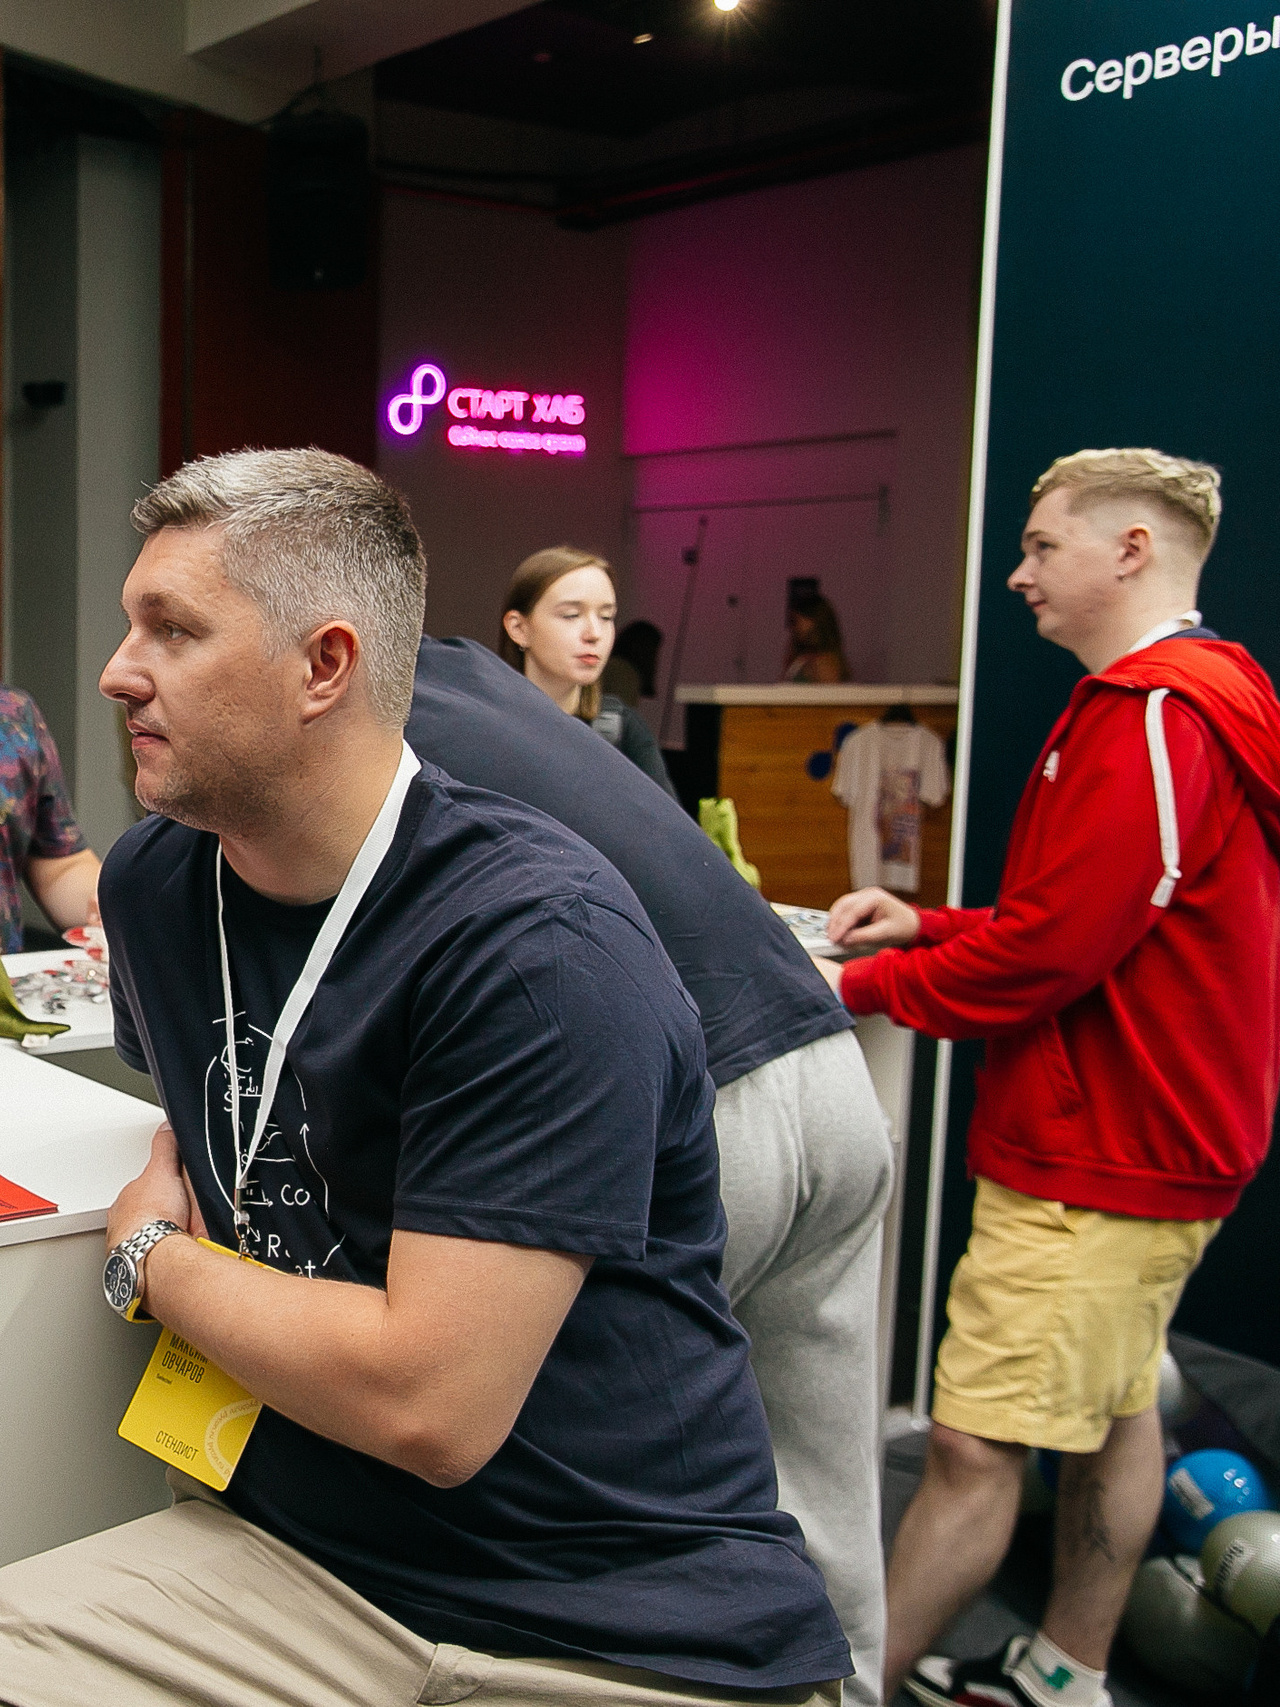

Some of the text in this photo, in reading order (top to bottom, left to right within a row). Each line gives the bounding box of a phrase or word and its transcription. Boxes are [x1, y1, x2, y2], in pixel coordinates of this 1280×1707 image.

[1060, 14, 1280, 101] Серверы
[447, 387, 585, 425] СТАРТ ХАБ
[161, 1350, 205, 1384] ОВЧАРОВ
[155, 1430, 199, 1462] СТЕНДИСТ
